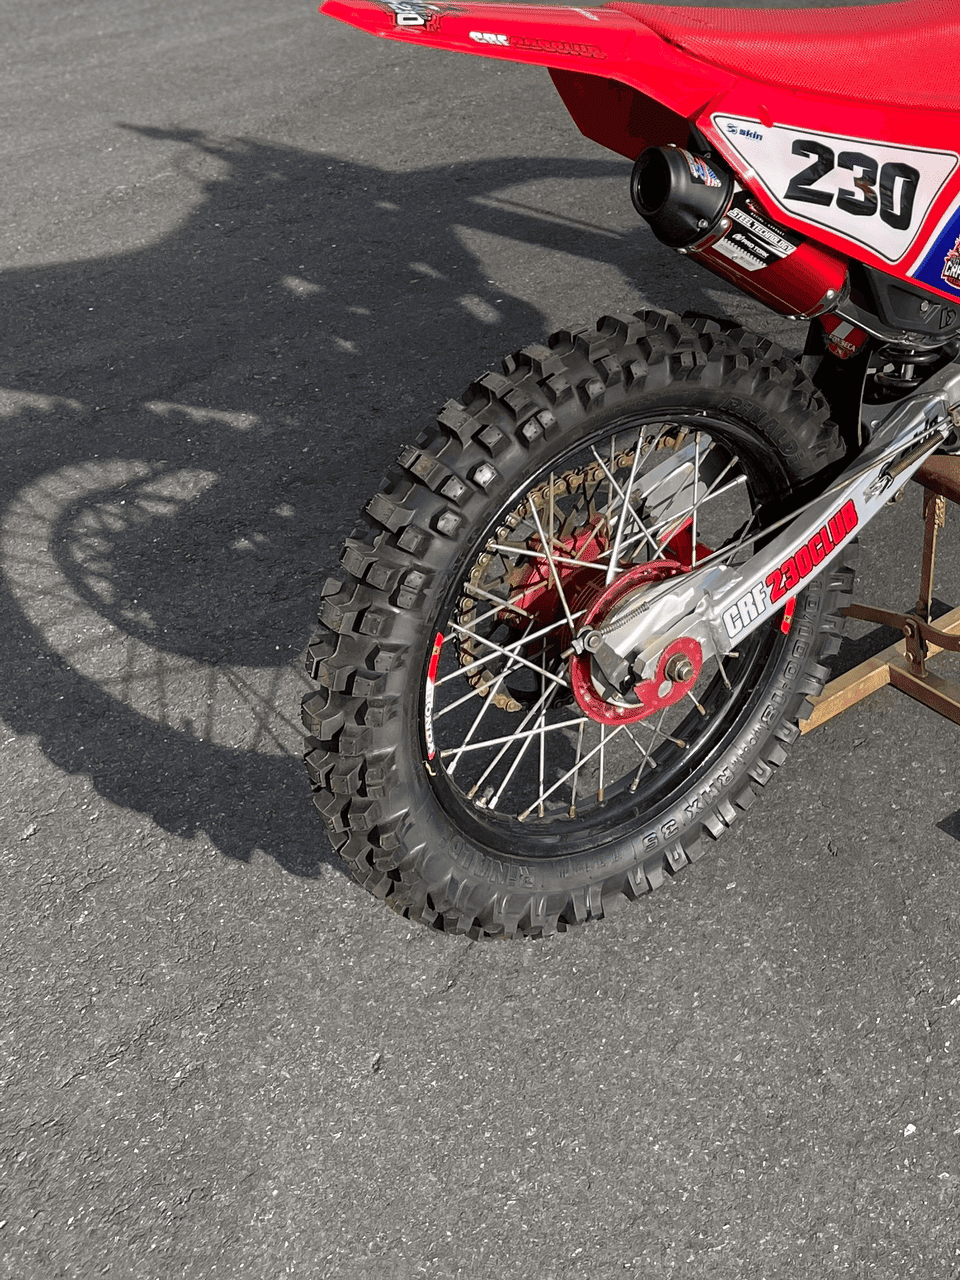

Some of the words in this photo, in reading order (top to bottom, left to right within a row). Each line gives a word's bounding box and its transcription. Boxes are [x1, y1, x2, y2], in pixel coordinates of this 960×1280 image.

[739, 128, 763, 141] skin
[783, 139, 920, 231] 230
[729, 207, 753, 227] STEEL
[750, 221, 794, 253] TECHNOLOGY
[761, 570, 824, 724] 10/100-18
[685, 769, 735, 820] RMX
[643, 819, 679, 852] 35
